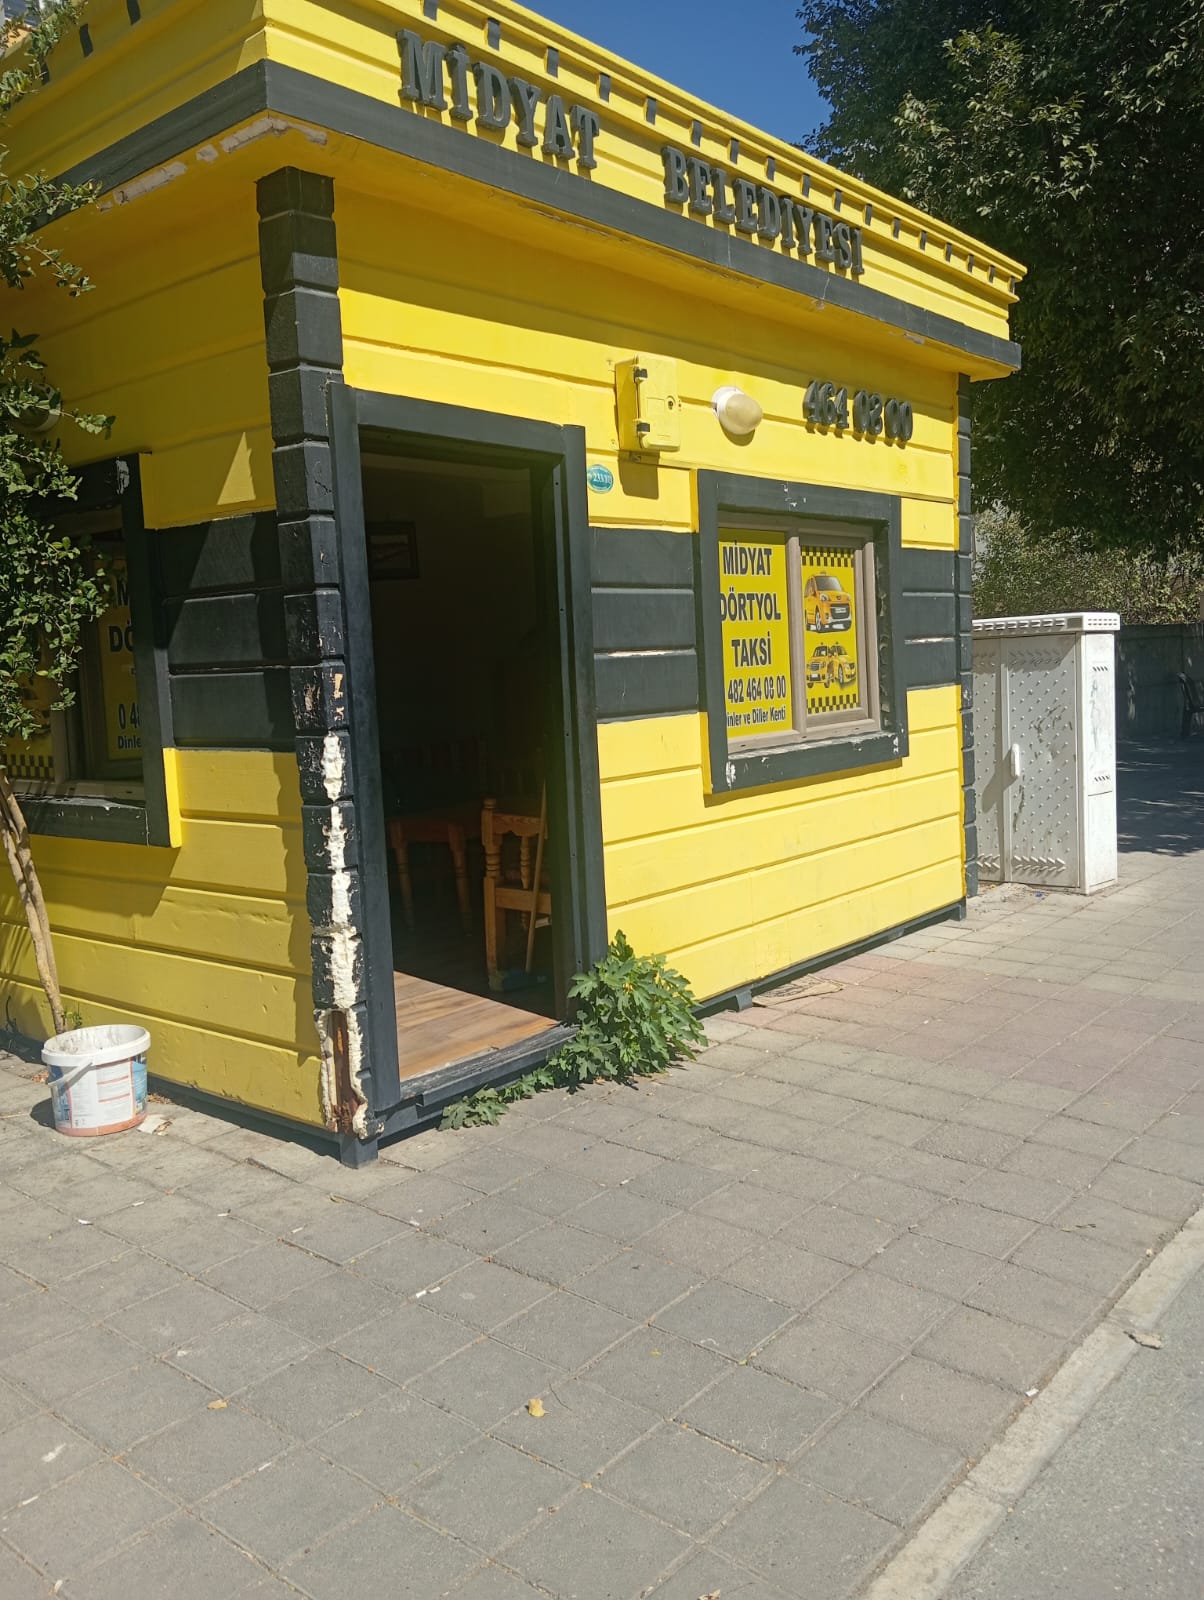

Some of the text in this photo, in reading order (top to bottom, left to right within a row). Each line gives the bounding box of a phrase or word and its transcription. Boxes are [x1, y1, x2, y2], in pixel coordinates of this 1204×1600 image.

[803, 380, 849, 429] 464
[884, 398, 913, 441] 00
[722, 541, 772, 576] MİDYAT
[720, 587, 782, 622] DÖRTYOL
[731, 631, 772, 667] TAKSİ
[728, 679, 745, 704] 482
[746, 677, 762, 702] 464
[777, 675, 786, 698] 00
[727, 706, 786, 726] inler ve Diller Kenti
